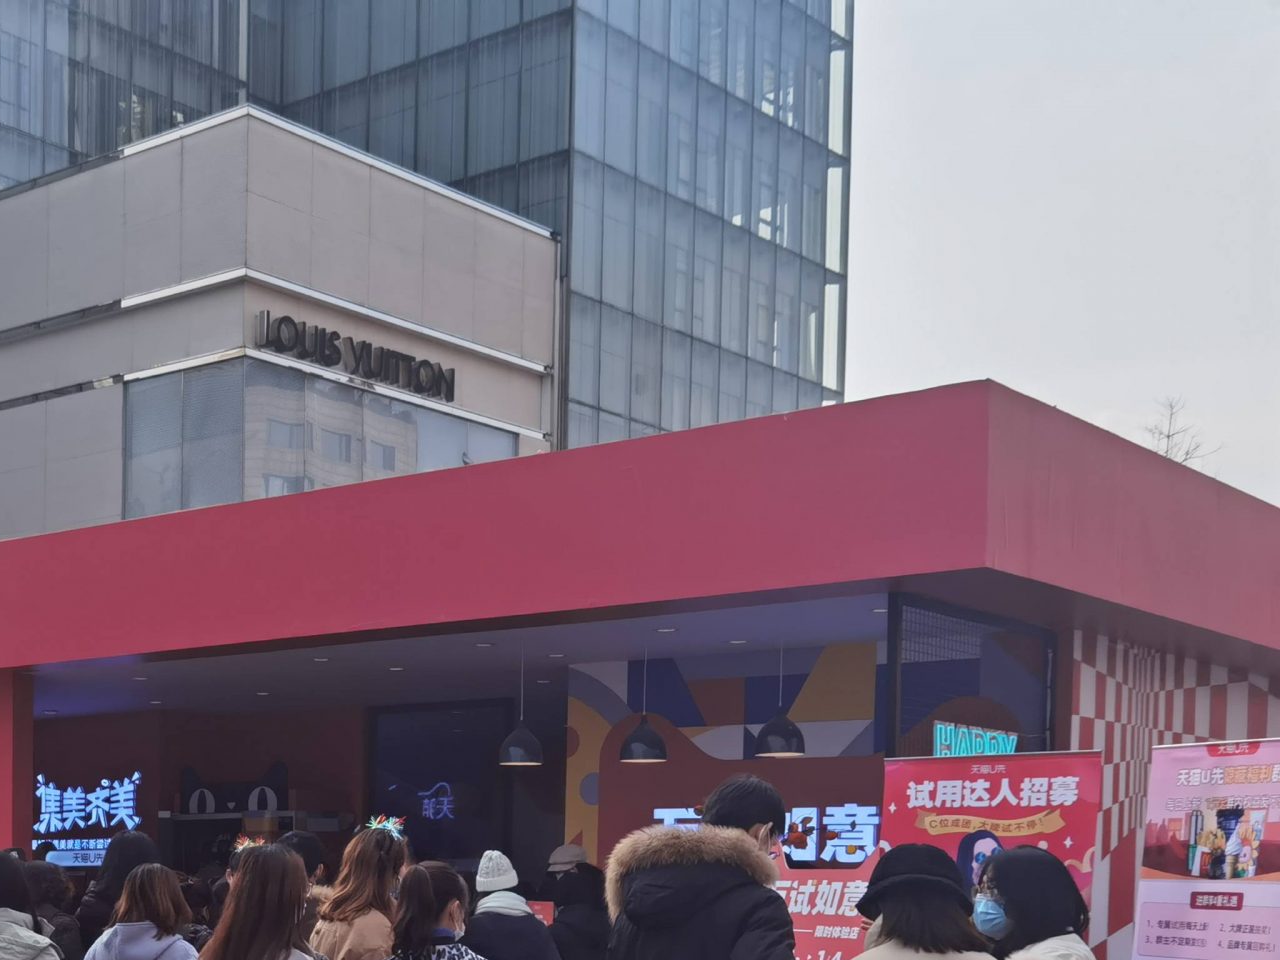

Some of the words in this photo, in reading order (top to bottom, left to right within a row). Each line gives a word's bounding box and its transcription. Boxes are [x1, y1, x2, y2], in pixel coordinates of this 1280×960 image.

[255, 309, 342, 368] LOUIS
[341, 336, 456, 403] VUITTON
[906, 775, 1080, 808] 试用达人招募
